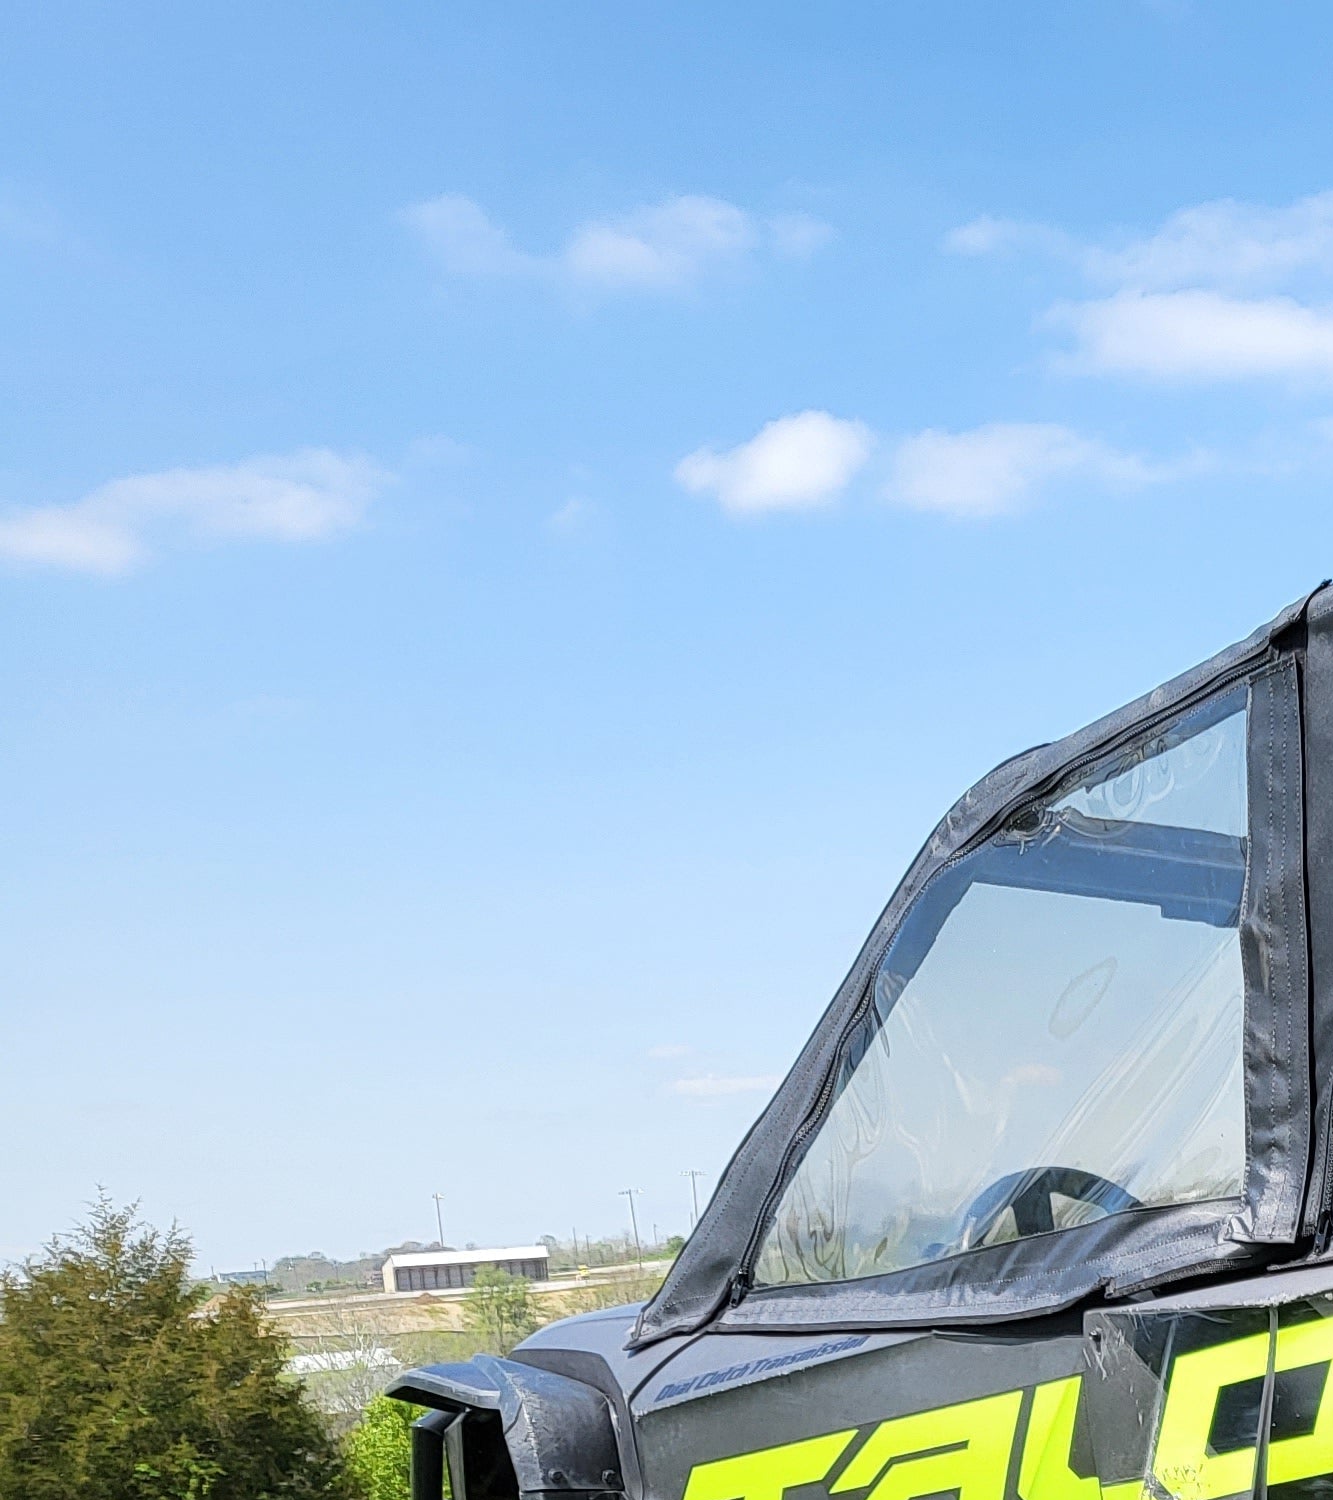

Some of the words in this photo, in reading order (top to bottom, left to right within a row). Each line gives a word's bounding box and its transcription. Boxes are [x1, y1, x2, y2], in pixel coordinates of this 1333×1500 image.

[654, 1376, 697, 1403] Dual
[696, 1363, 750, 1390] Clutch
[749, 1335, 872, 1376] Transmission
